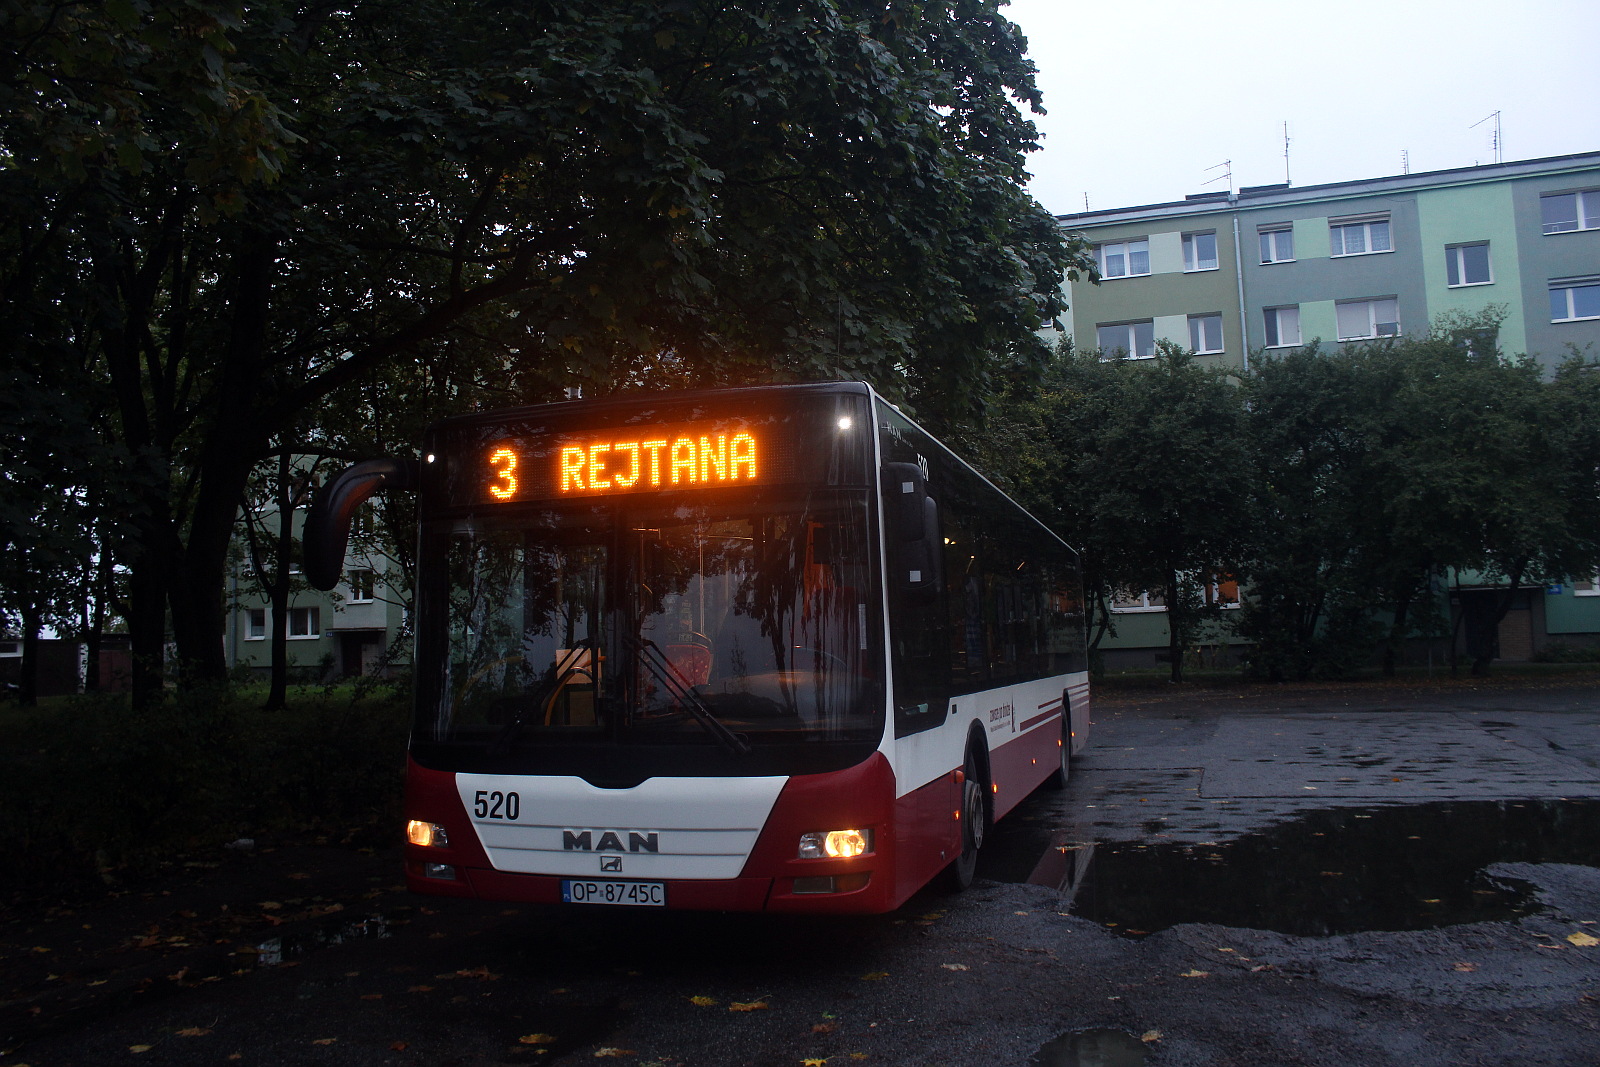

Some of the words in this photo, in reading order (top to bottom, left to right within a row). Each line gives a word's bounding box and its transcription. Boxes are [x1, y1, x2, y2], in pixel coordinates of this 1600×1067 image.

[489, 447, 517, 500] 3
[560, 432, 758, 494] REJTANA
[475, 791, 520, 820] 520
[563, 829, 659, 852] MAN
[573, 883, 598, 902] OP
[605, 884, 662, 904] 8745C
